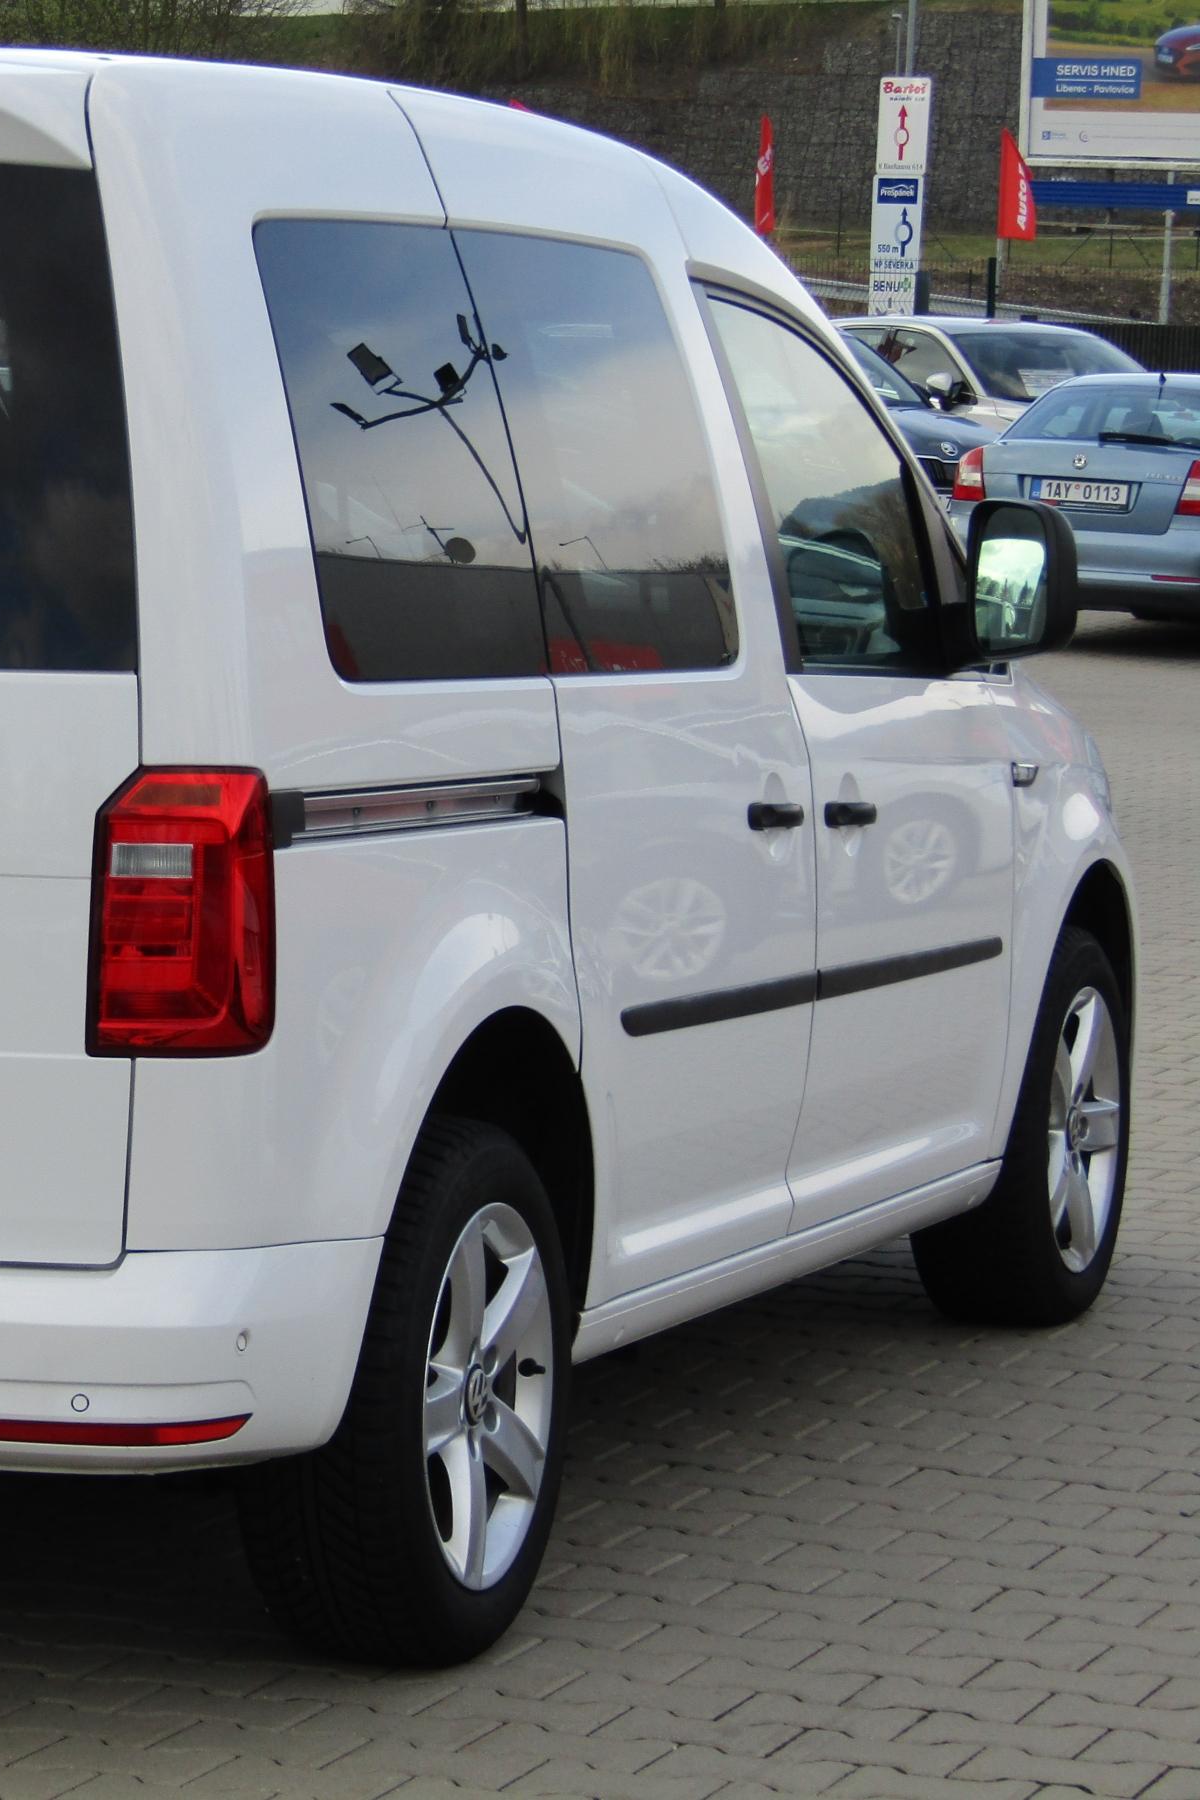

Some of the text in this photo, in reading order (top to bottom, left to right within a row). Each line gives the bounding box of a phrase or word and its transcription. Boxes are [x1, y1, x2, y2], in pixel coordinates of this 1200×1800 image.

[1056, 65, 1136, 77] SERVIS HNED
[1055, 84, 1087, 93] Liberec
[1093, 85, 1135, 94] Pavlovice
[878, 244, 891, 253] 550
[873, 280, 901, 293] BENU
[1046, 482, 1120, 502] 1AY 0113
